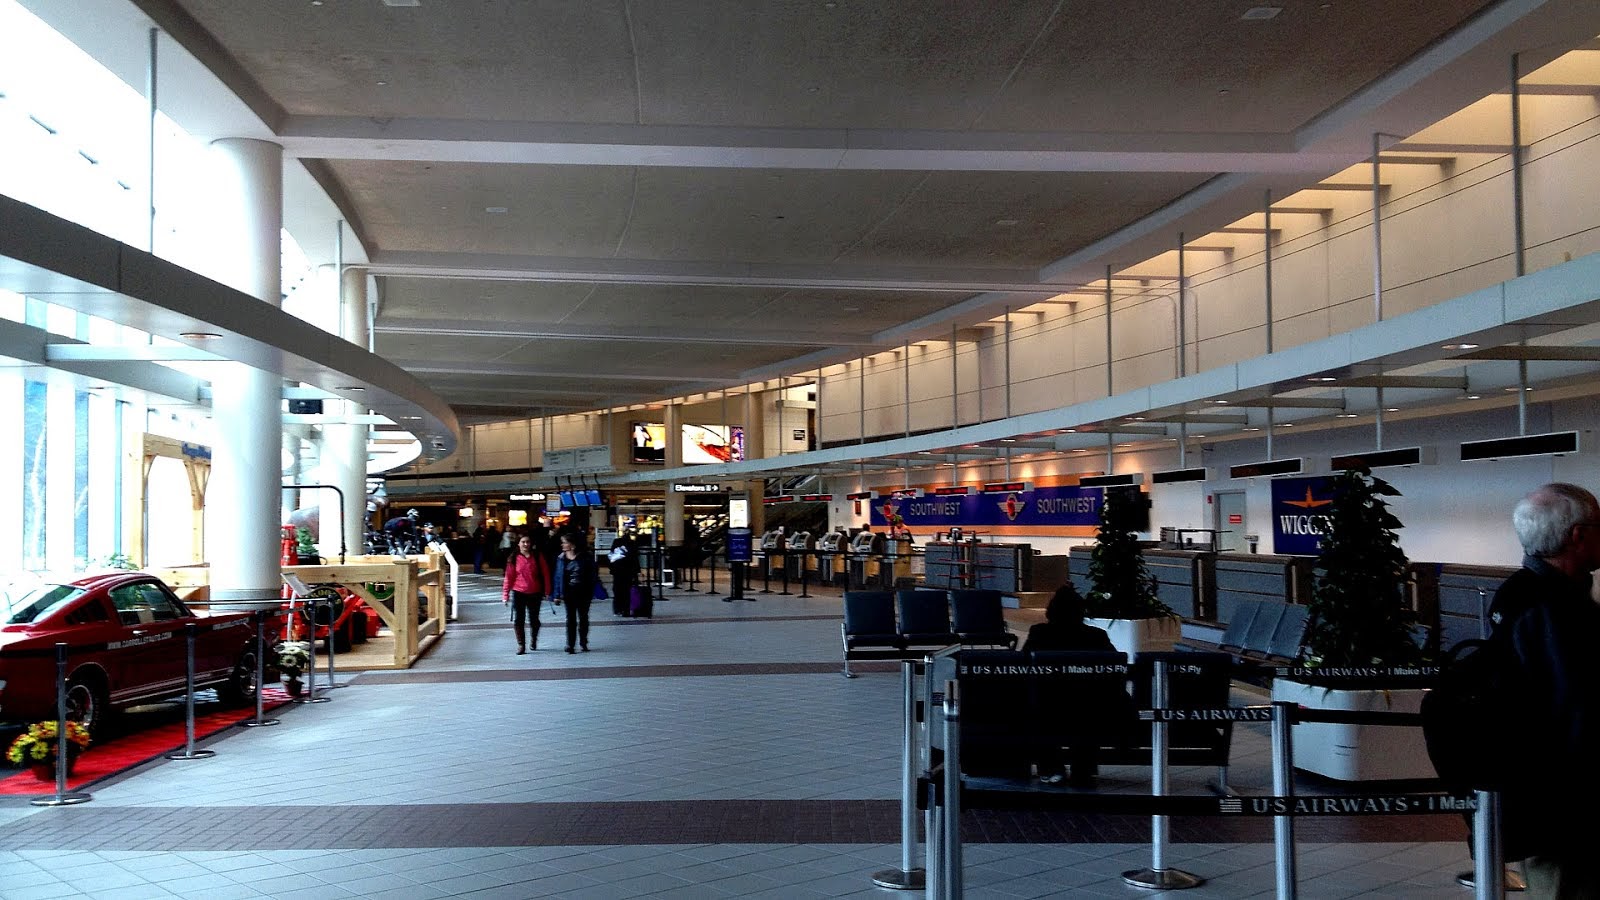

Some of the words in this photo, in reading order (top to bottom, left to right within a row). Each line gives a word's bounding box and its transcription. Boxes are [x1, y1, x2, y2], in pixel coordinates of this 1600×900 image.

[910, 502, 961, 516] SOUTHWEST
[1036, 497, 1096, 513] SOUTHWEST
[1279, 514, 1335, 535] WIGGN
[993, 665, 1053, 675] AIRWAYS
[1068, 665, 1093, 674] Make
[1114, 664, 1129, 674] Fly
[1187, 664, 1202, 675] Fly
[1316, 667, 1377, 677] AIRWAYS
[1393, 667, 1420, 675] Make
[1188, 709, 1271, 720] AIRWAYS
[1294, 797, 1408, 813] AIRWAYS
[1428, 797, 1434, 810] I
[1439, 795, 1477, 810] Mak
